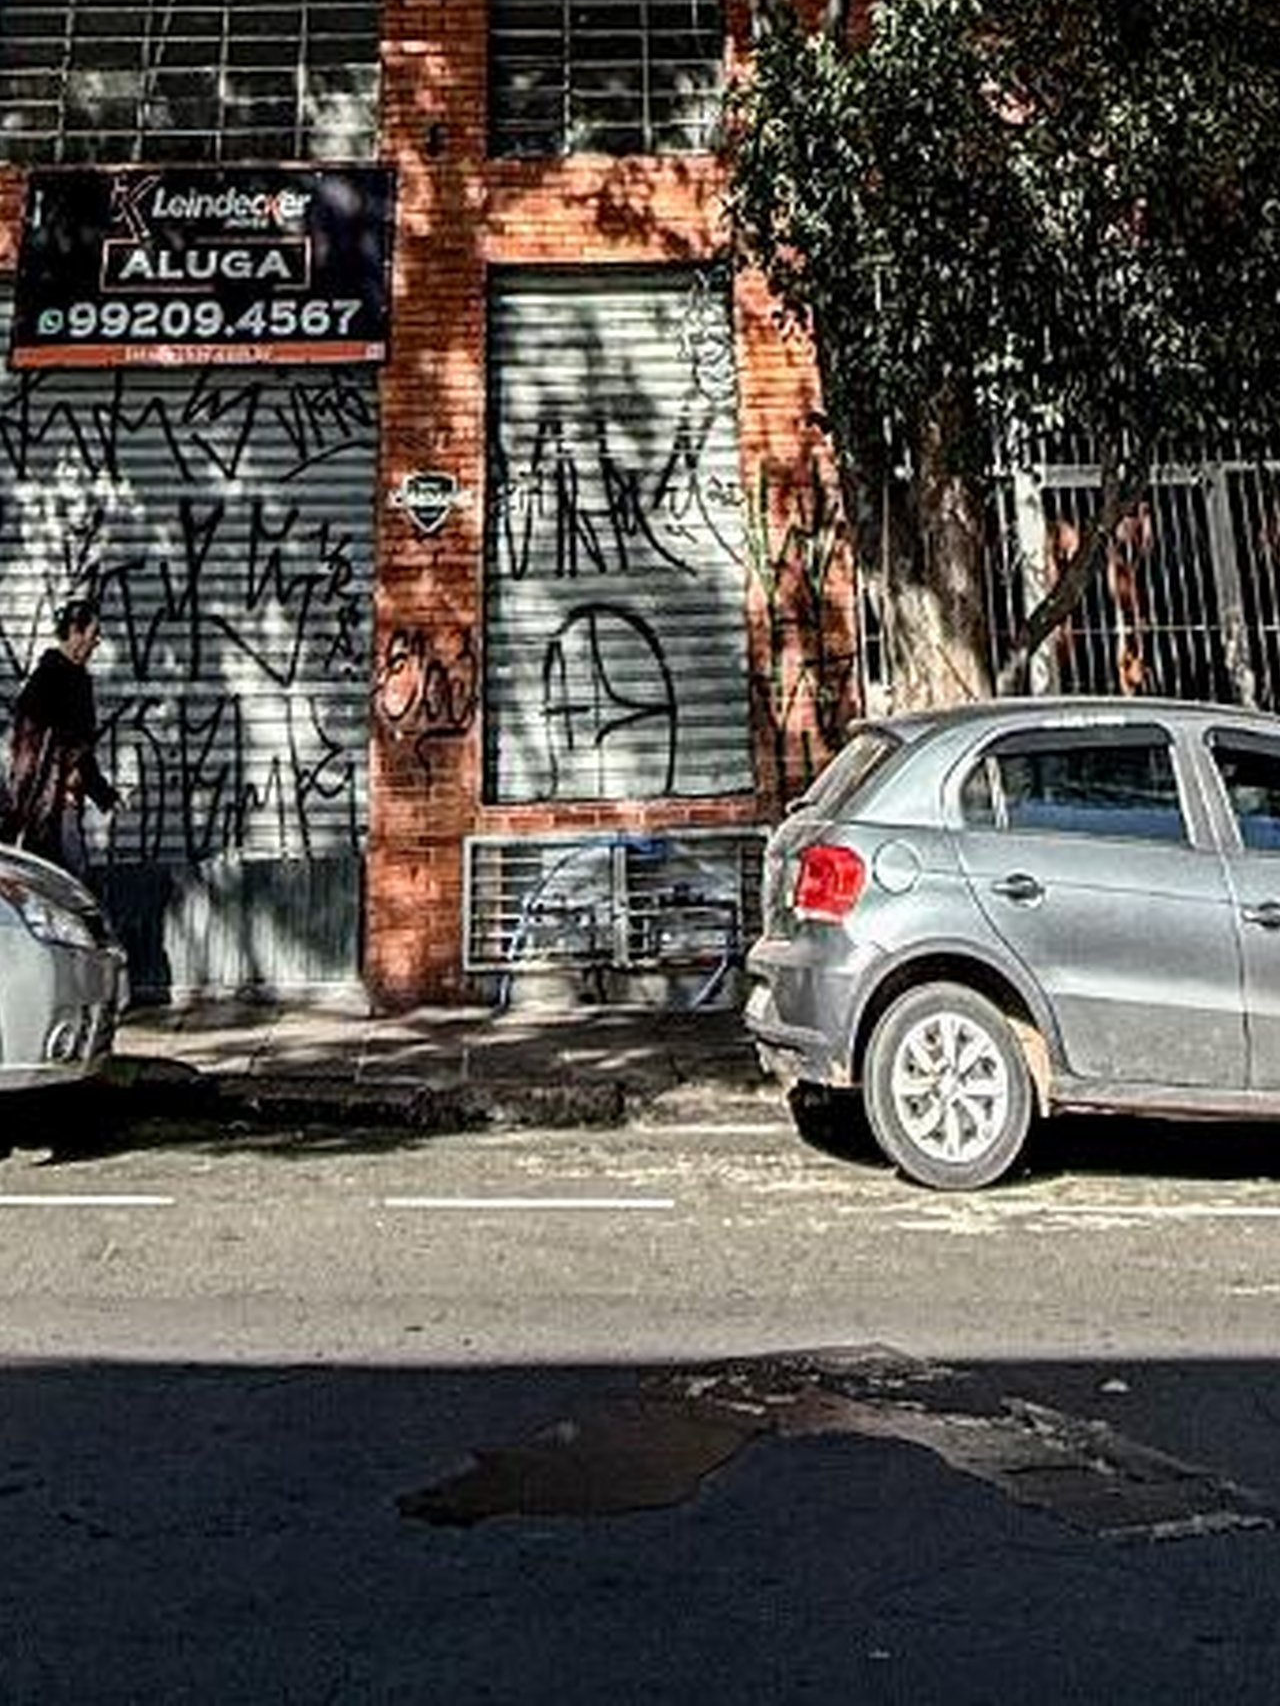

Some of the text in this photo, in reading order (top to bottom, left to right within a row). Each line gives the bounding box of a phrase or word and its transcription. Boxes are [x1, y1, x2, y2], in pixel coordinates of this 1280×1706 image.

[152, 186, 313, 224] Leindecker
[119, 250, 292, 279] ALUGA
[70, 299, 363, 337] 99209.4567
